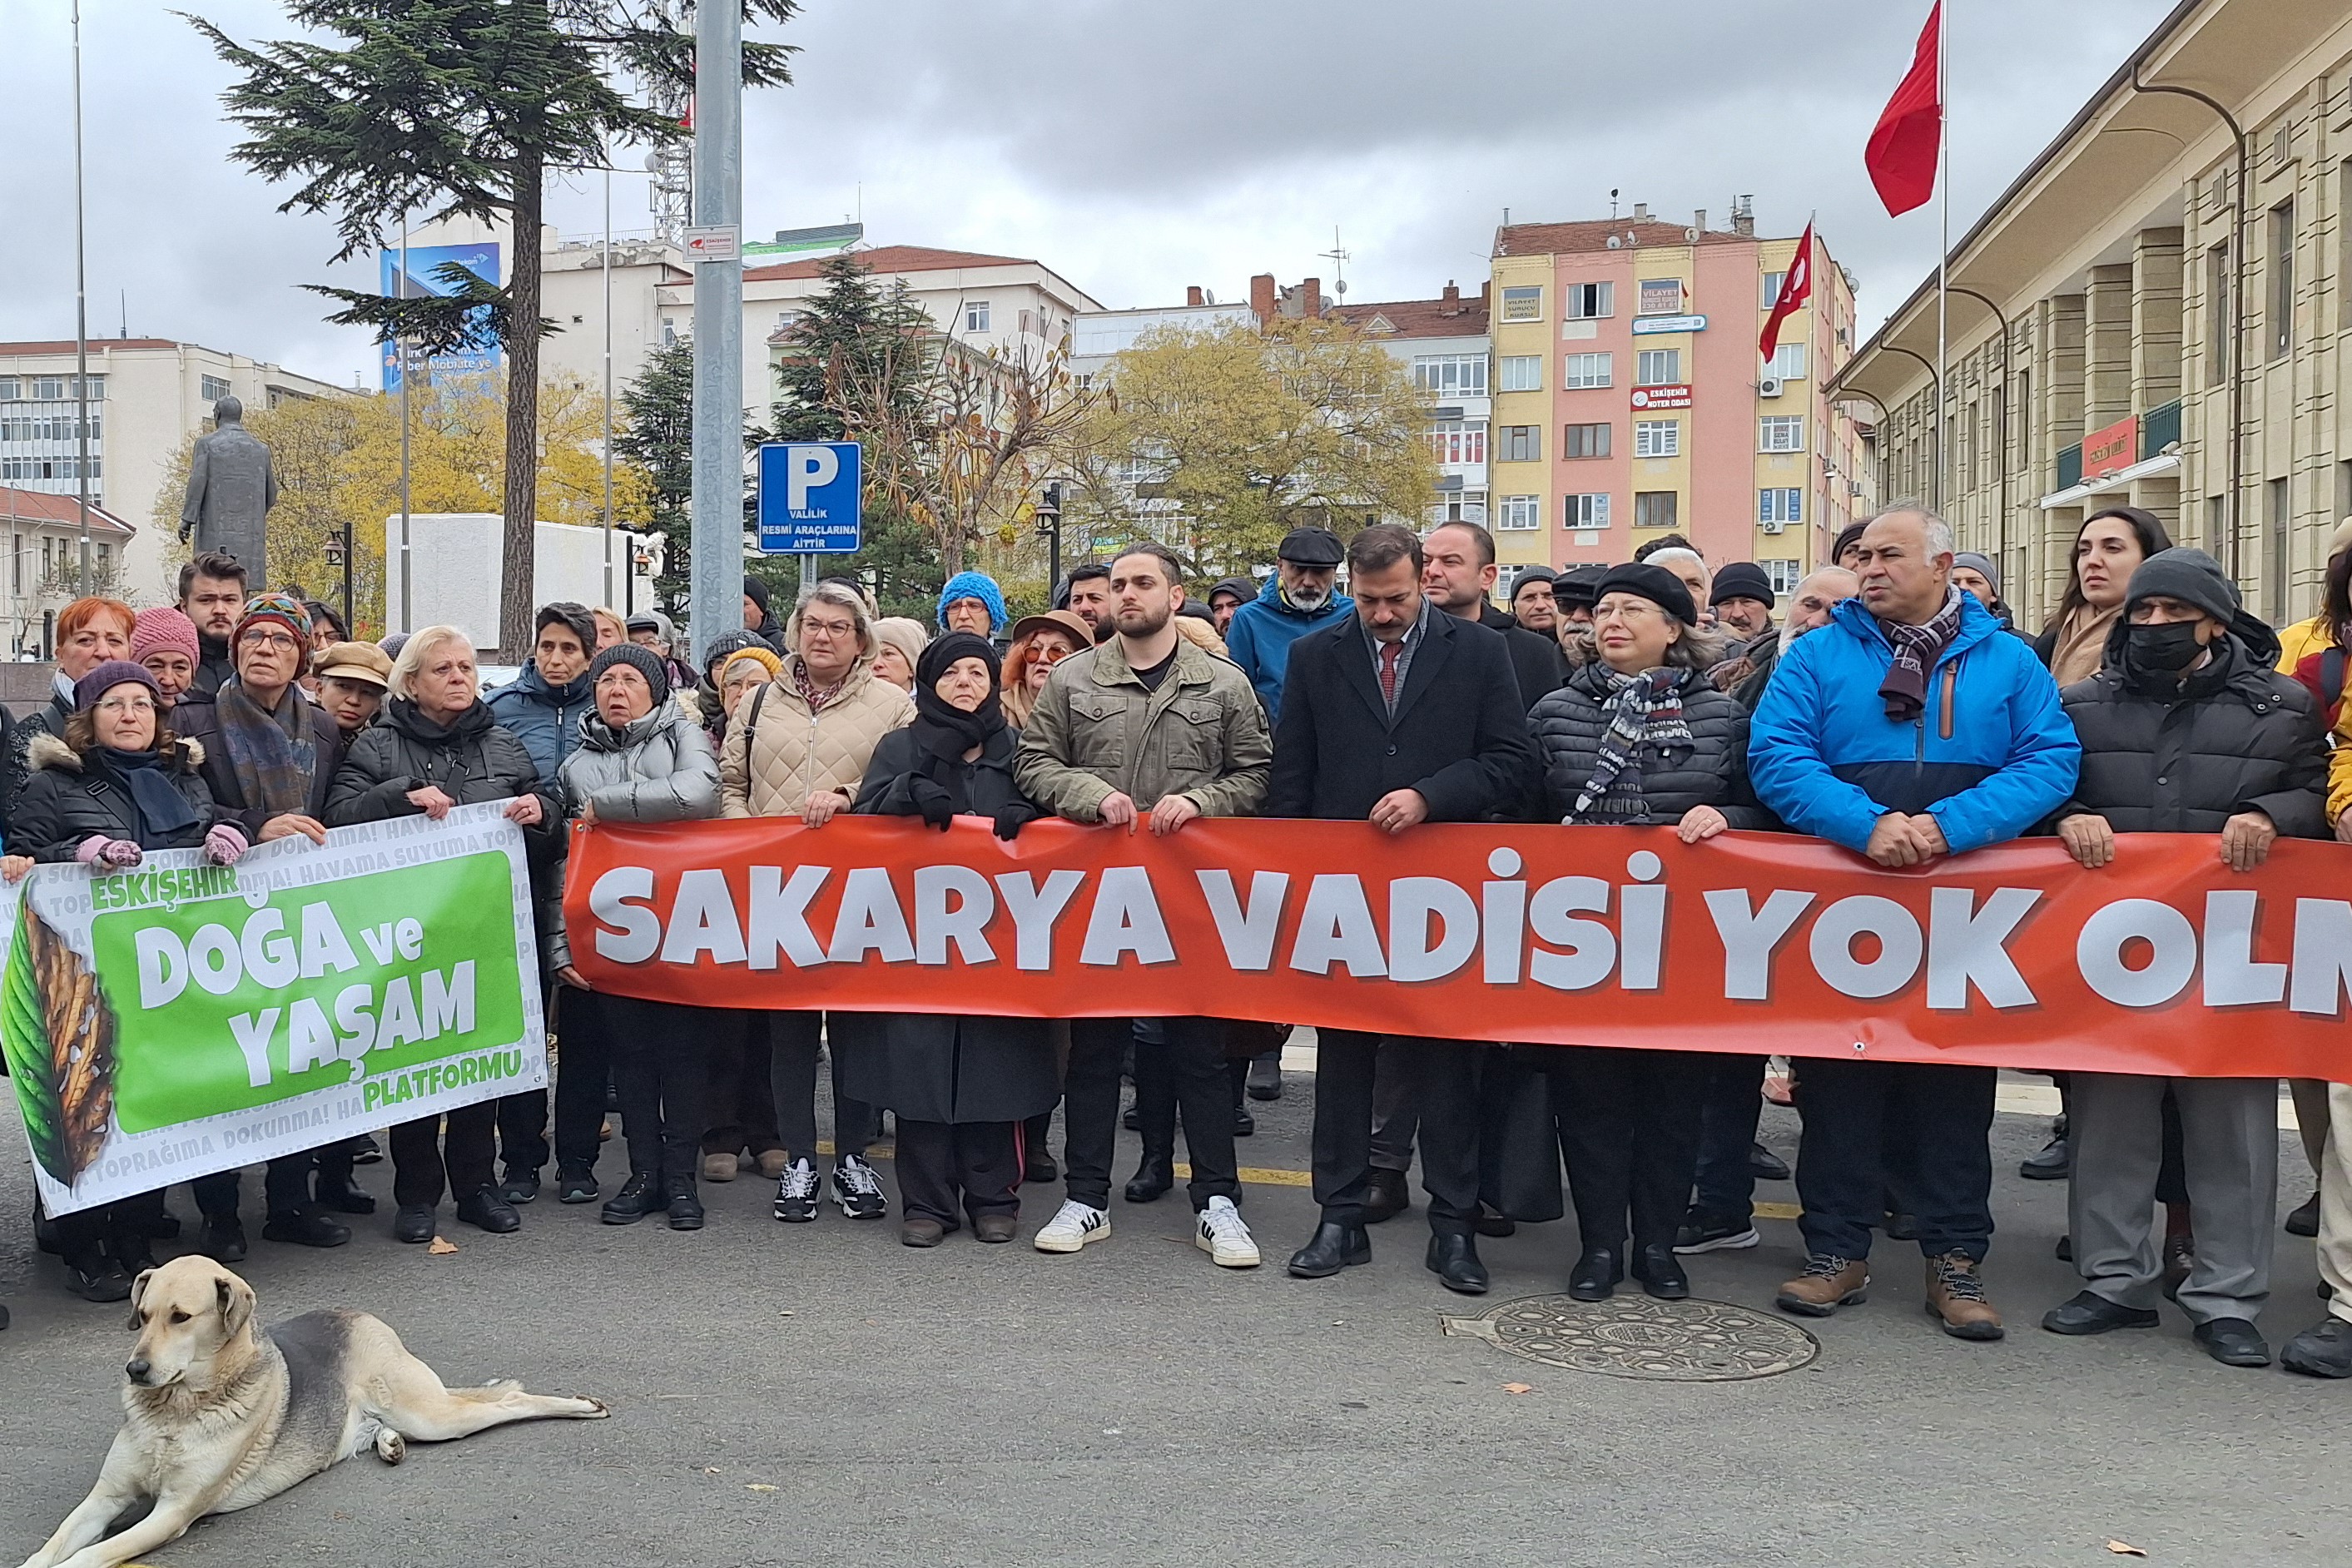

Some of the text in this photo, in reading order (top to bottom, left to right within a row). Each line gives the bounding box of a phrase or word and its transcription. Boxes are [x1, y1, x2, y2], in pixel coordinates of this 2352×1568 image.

[788, 446, 838, 509] P
[762, 523, 857, 536] RESMİ ARAÇLARINA
[789, 508, 828, 519] VALİLİK
[792, 537, 826, 548] AİTTİR
[394, 835, 480, 866] SUYUMA
[134, 886, 360, 1010] DOĞA
[360, 917, 424, 966] ve
[588, 865, 1177, 970] SAKARYA
[1194, 846, 1667, 990] VADİSİ
[1702, 886, 2044, 1010] YOK
[227, 959, 475, 1088] YAŞAM
[363, 1049, 522, 1113] PLATFORMU
